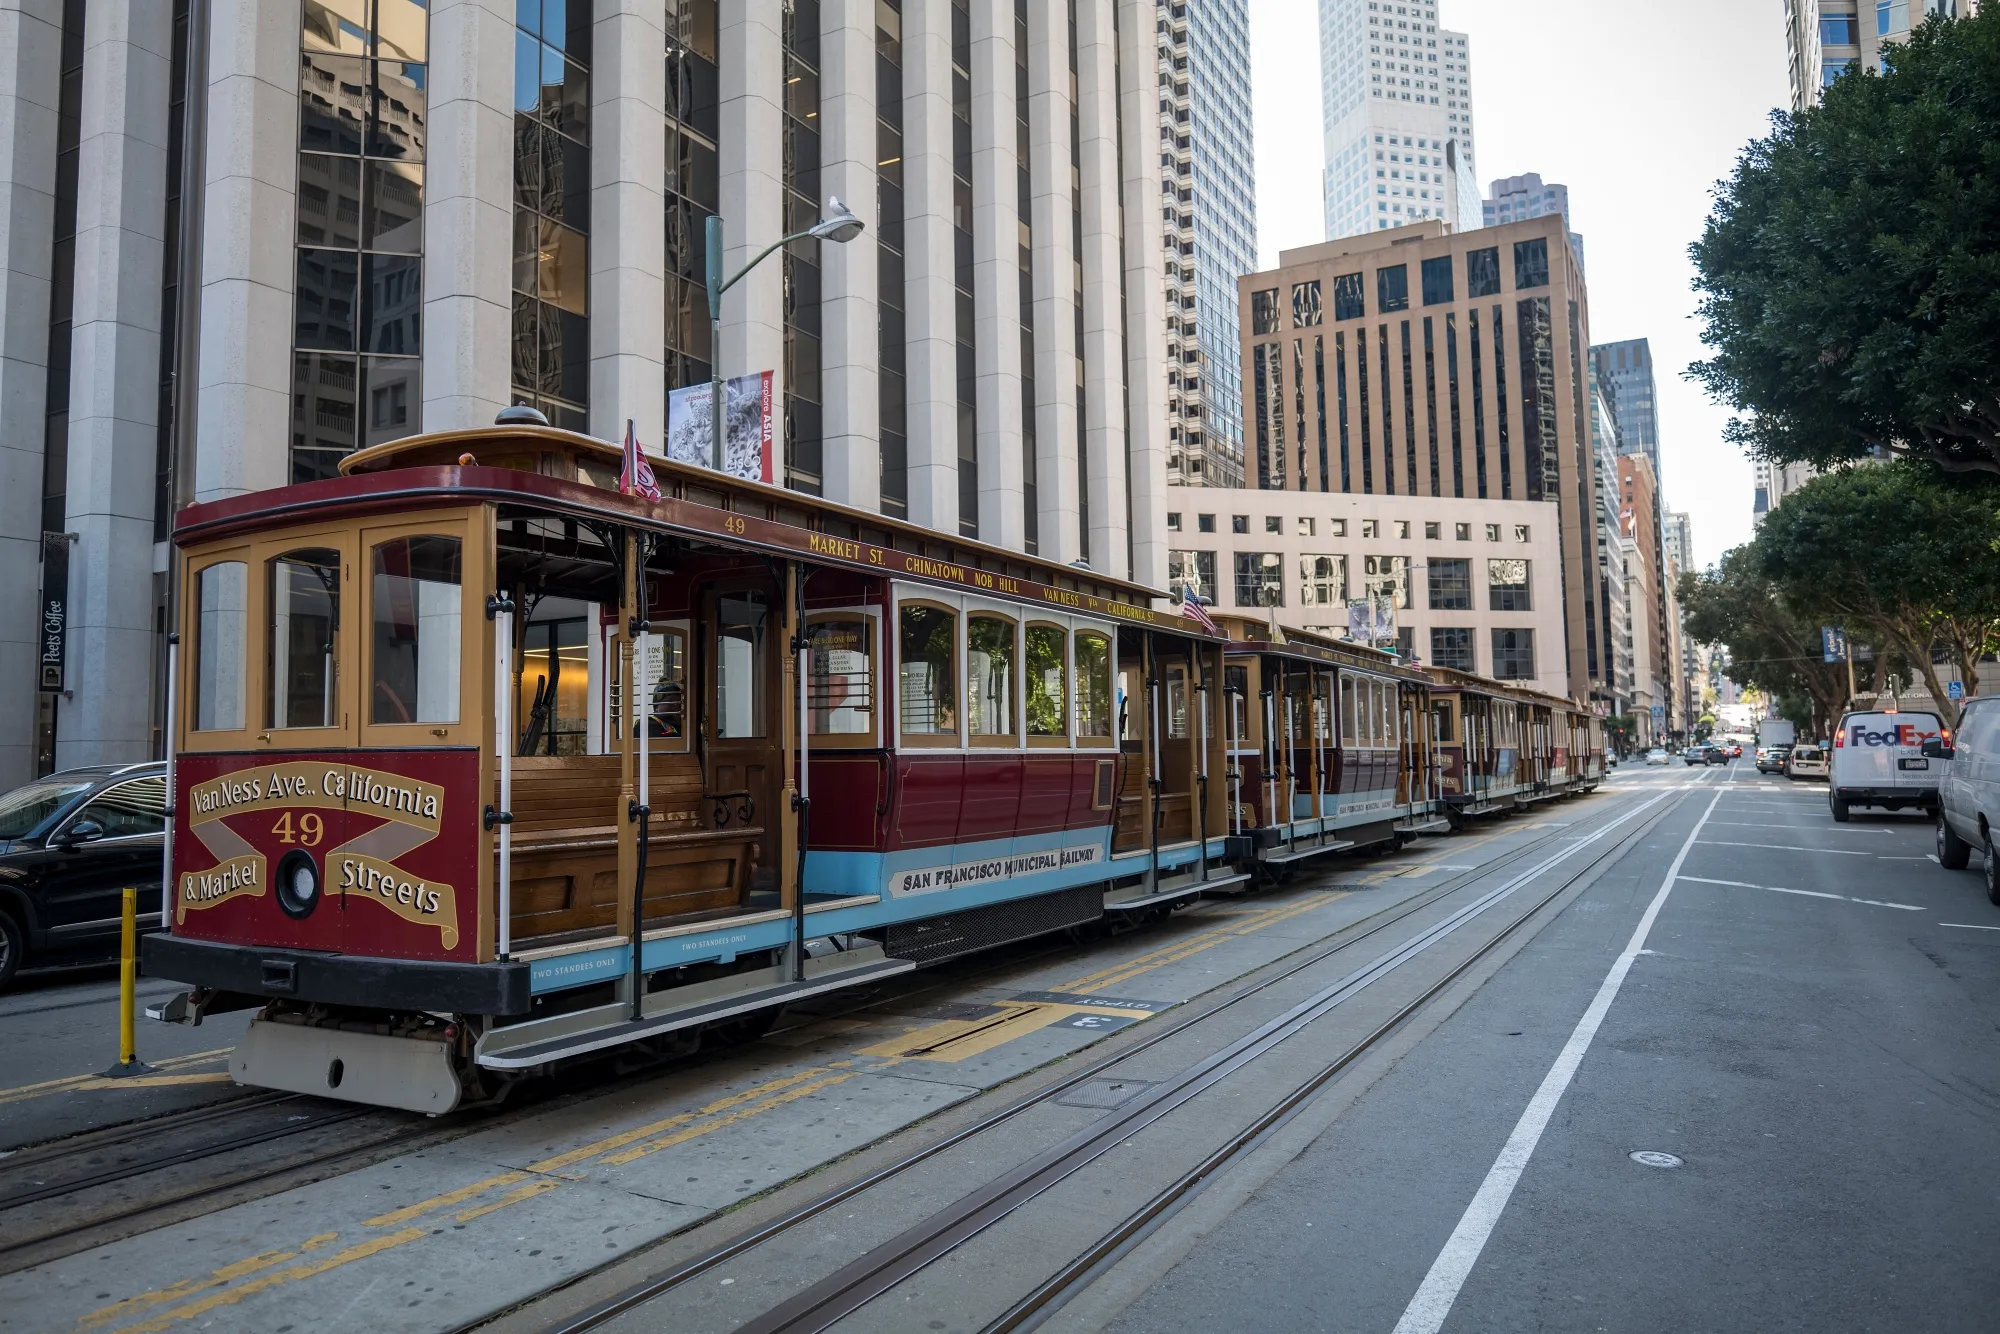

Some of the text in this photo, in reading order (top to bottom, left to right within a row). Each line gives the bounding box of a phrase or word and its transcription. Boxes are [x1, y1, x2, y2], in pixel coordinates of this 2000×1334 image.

[762, 380, 772, 442] explore ASIA
[724, 516, 745, 534] 49
[810, 534, 860, 560] MARKET
[906, 557, 964, 582] CHINATOWN
[974, 572, 992, 588] NOB
[999, 577, 1019, 593] HILL
[1107, 602, 1146, 621] CALIFORNIA
[1176, 618, 1184, 628] 49
[44, 600, 64, 634] Coffee
[1851, 724, 1936, 747] FedEx
[322, 770, 438, 819] California
[271, 811, 324, 847] 49
[186, 860, 258, 900] & Market
[340, 860, 441, 916] Streets
[903, 848, 1095, 892] SAN FRANCISCO MUNICIPAL RAILWAY
[681, 934, 747, 951] TWO STANDEES ONLY
[532, 957, 616, 980] TWO STANDEES ONLY
